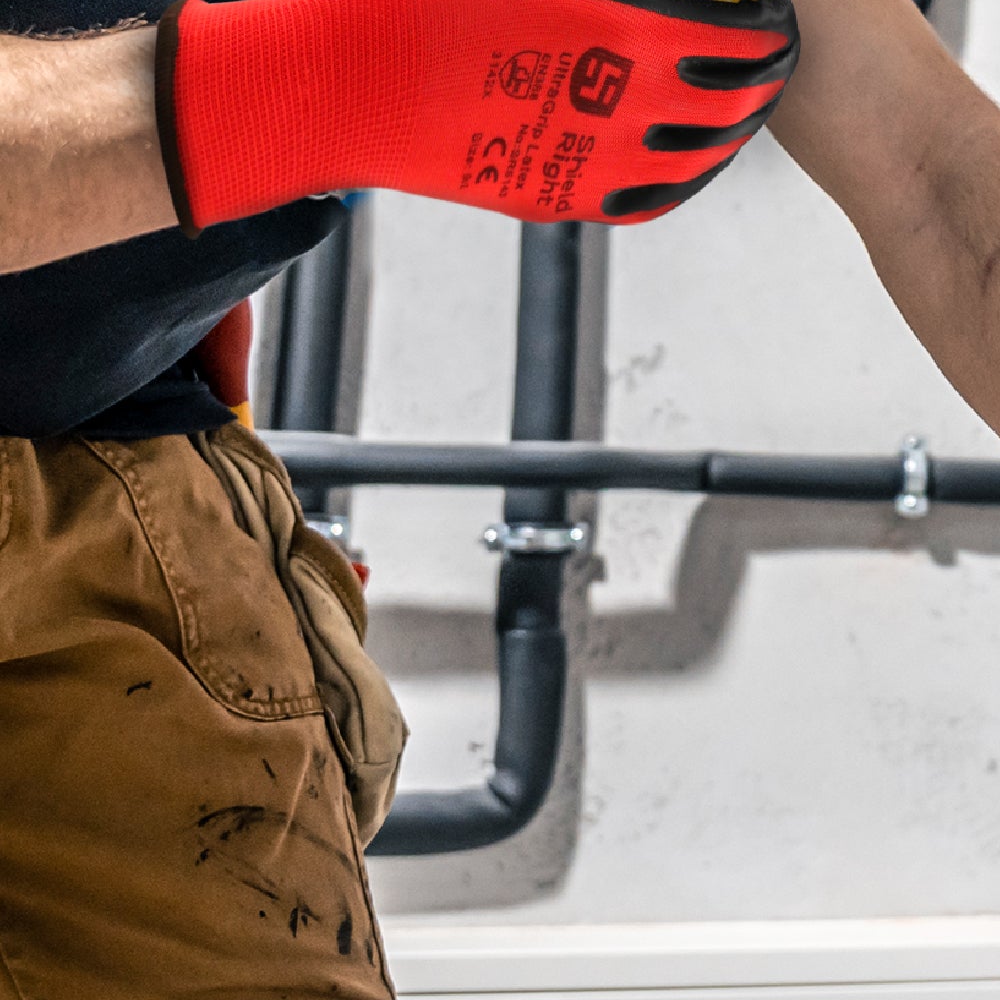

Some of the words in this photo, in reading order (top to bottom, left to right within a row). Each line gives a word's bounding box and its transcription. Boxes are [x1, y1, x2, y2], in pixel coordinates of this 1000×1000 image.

[515, 144, 539, 190] Latex
[537, 132, 577, 206] Right
[555, 135, 595, 213] Shield
